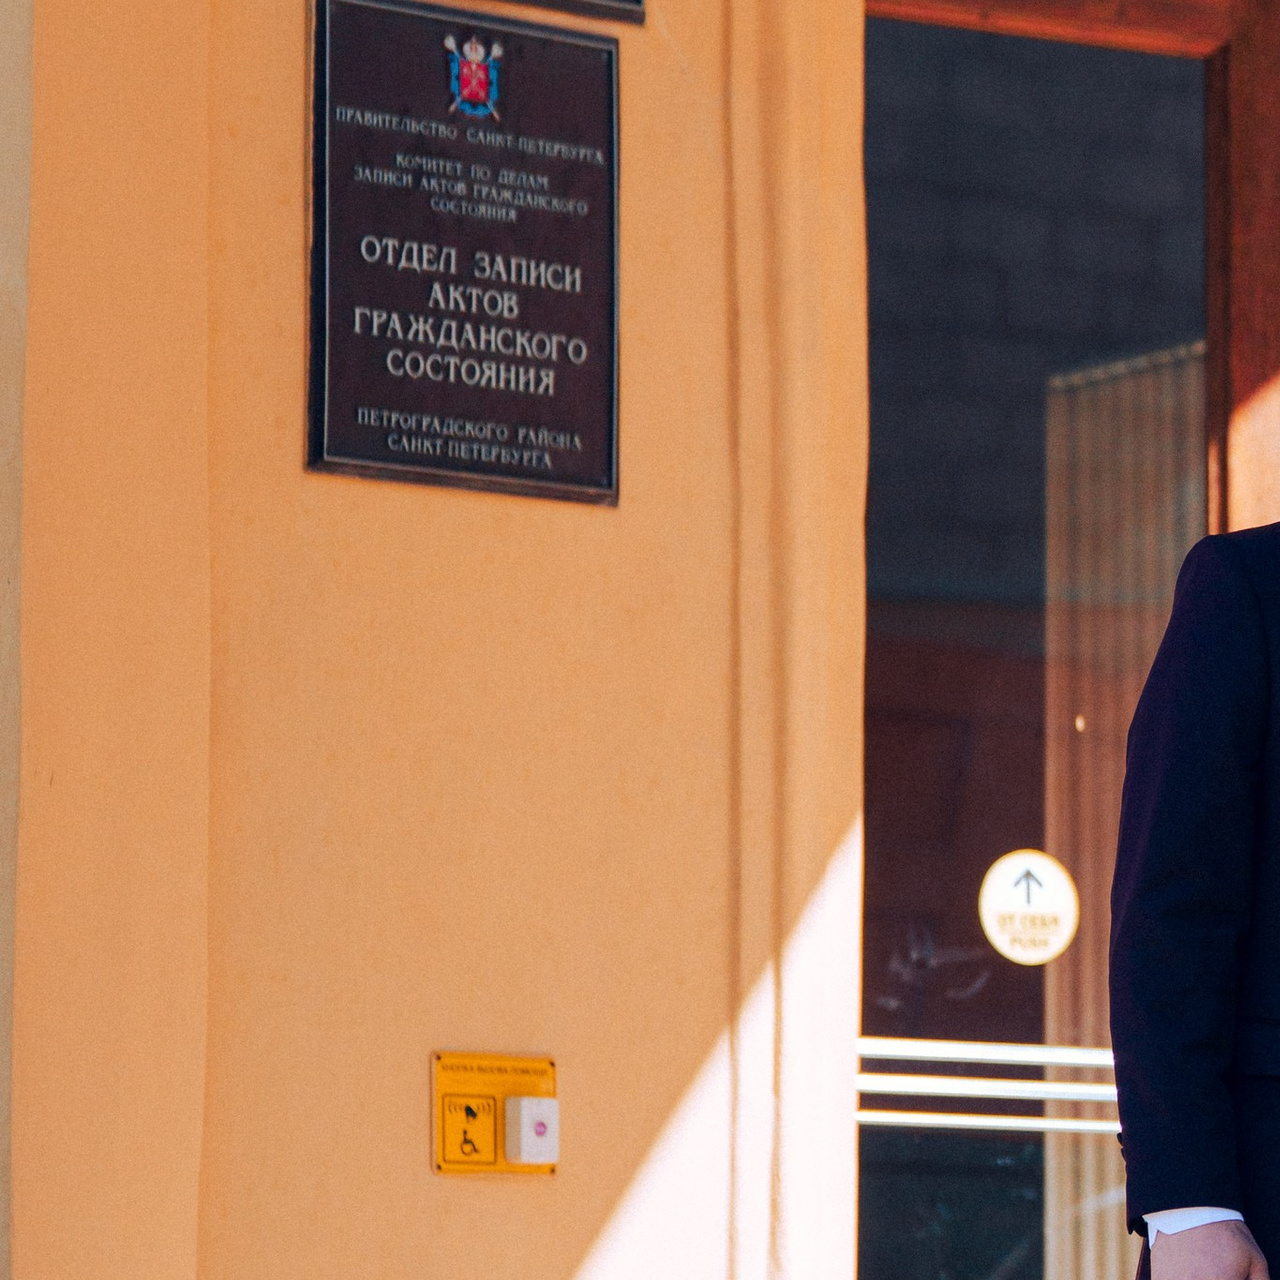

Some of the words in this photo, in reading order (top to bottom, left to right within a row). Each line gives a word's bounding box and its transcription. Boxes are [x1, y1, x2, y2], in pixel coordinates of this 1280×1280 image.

[336, 106, 457, 140] ПРАВИТЕЛЬСТВО
[354, 164, 413, 189] ЗАПИСИ
[420, 175, 467, 197] АКТОВ
[473, 182, 588, 216] ГРАЖДАНСКОГО
[396, 152, 463, 176] КОМИТЕТ
[471, 163, 491, 181] ПО
[497, 168, 549, 191] ДЕЛАМ
[430, 194, 517, 223] СОСТОЯНИЯ
[360, 235, 457, 275] ОТДЕЛ
[474, 251, 582, 293] ЗАПИСИ
[428, 281, 519, 320] АКТОВ
[353, 306, 588, 365] ГРАЖДАНСКОГО
[386, 348, 555, 396] СОСТОЯНИЯ
[357, 407, 508, 441] ПЕТРОГРАДСКОГО
[518, 425, 583, 451] РАЙОНА
